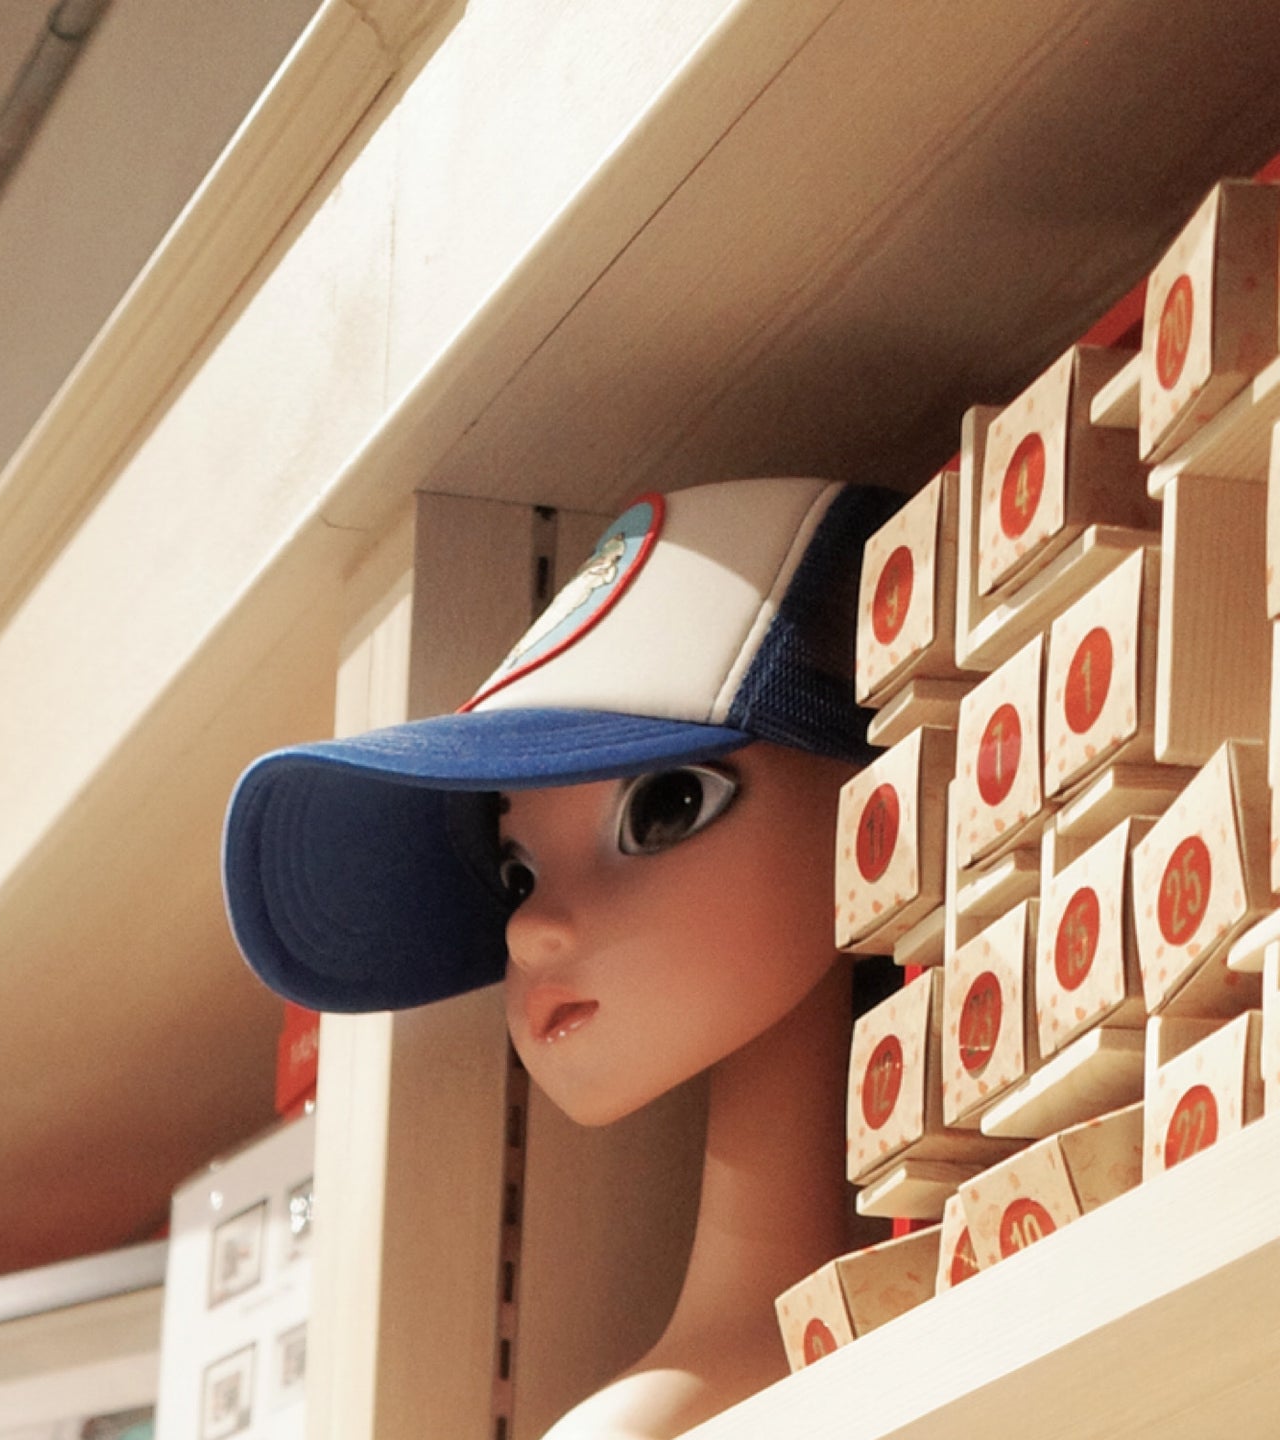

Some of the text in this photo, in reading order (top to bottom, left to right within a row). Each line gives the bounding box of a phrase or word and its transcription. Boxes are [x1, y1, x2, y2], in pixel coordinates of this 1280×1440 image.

[1162, 287, 1187, 380] 20
[1013, 460, 1031, 517] 4
[1165, 847, 1201, 936] 25
